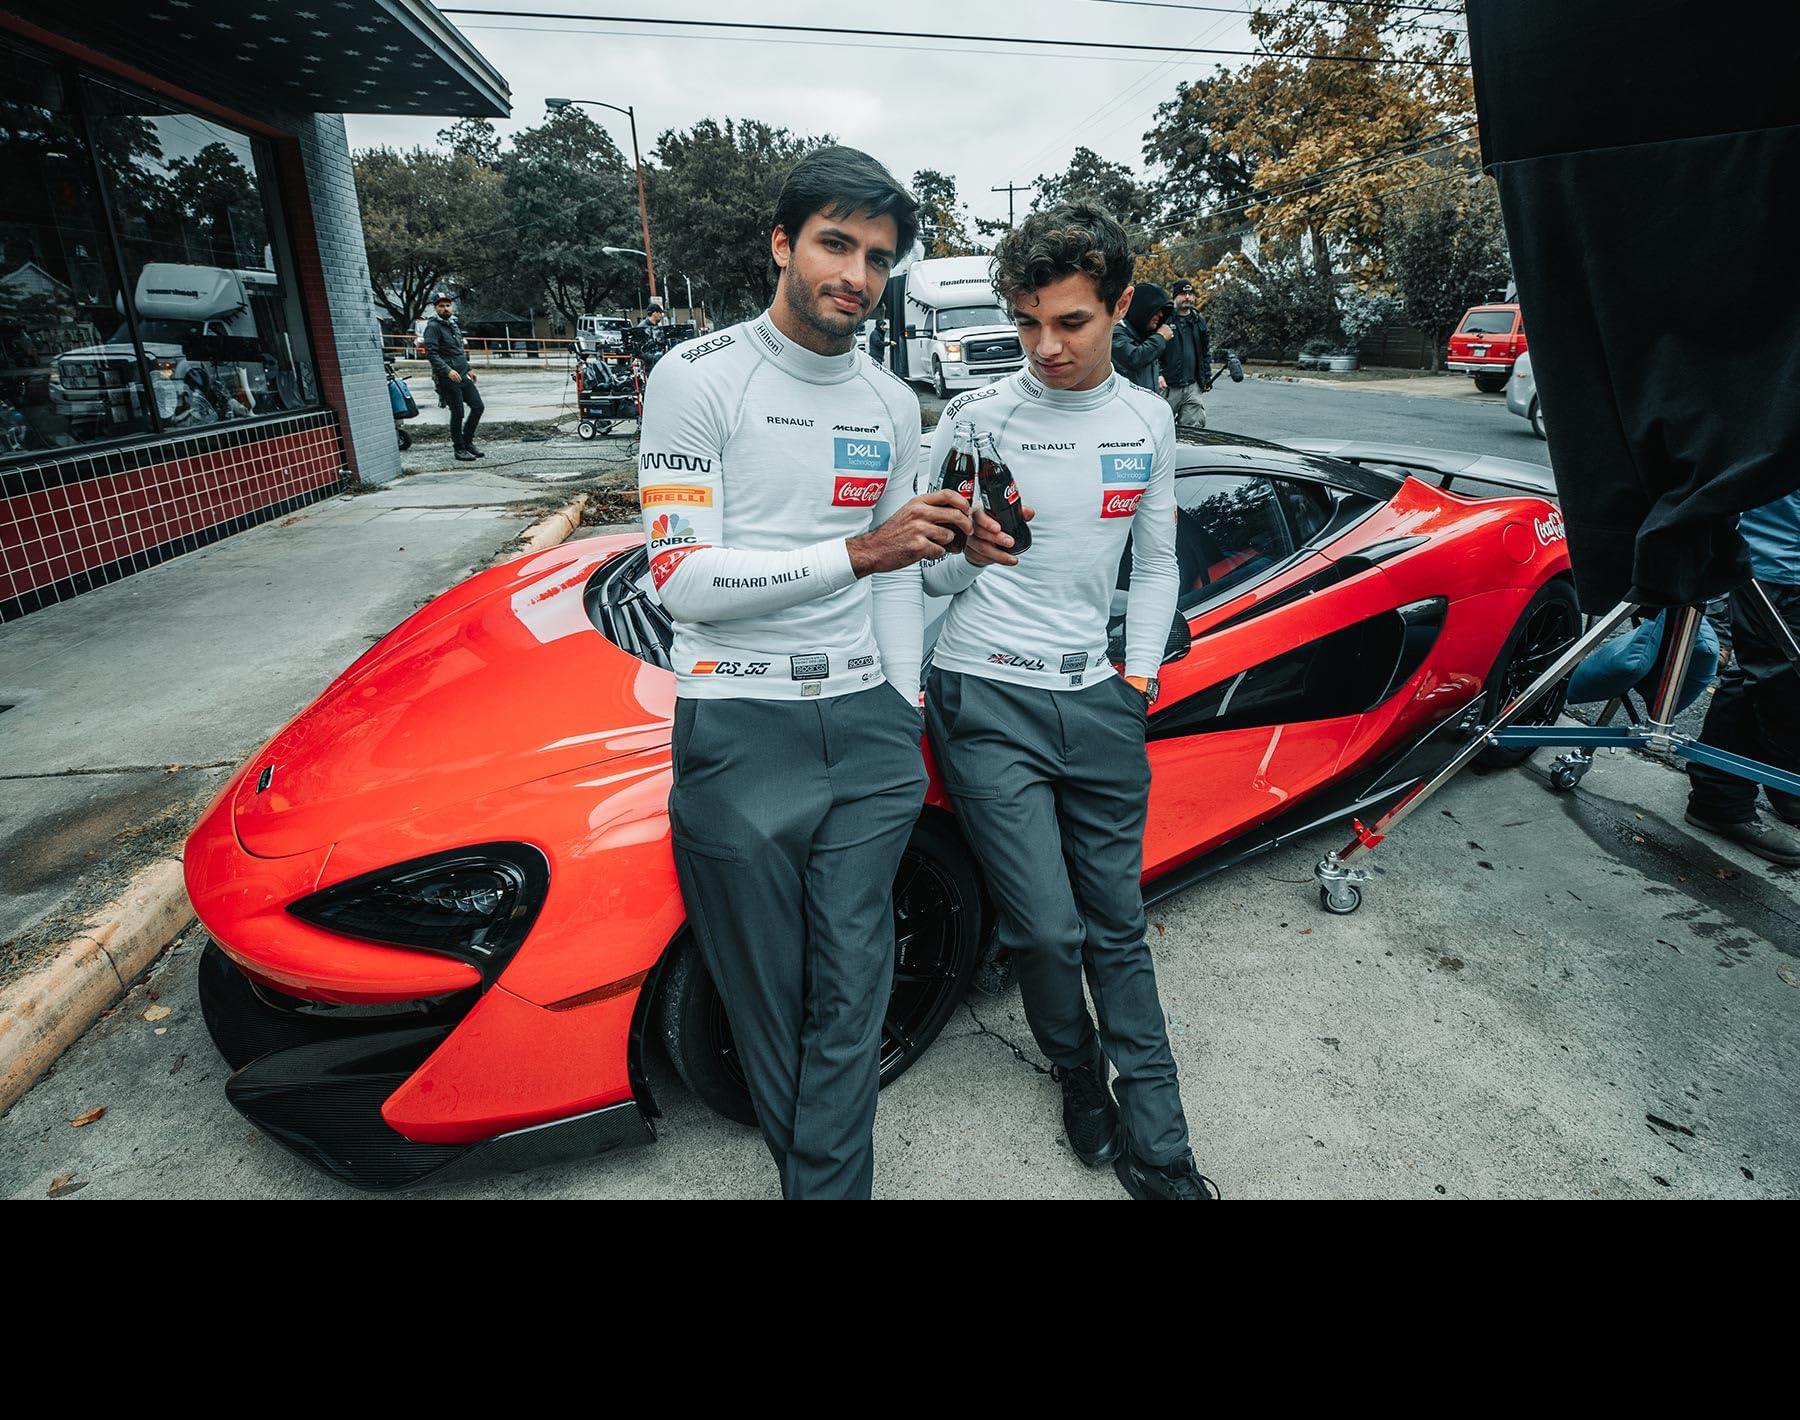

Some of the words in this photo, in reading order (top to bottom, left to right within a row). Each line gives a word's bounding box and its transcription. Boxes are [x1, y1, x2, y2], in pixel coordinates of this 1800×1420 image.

[757, 325, 779, 352] Hilton
[681, 335, 733, 361] sparco
[1020, 376, 1039, 396] Hilton
[947, 389, 998, 418] sparco
[767, 416, 814, 427] RENAULT
[832, 425, 877, 433] McLaren
[847, 443, 880, 457] DELL
[1114, 458, 1146, 470] DELL
[642, 488, 705, 504] PIRELLI
[838, 482, 884, 501] Coca-Cola
[651, 537, 697, 549] CNBC
[713, 577, 767, 588] RICHARD
[772, 567, 810, 584] MILLE
